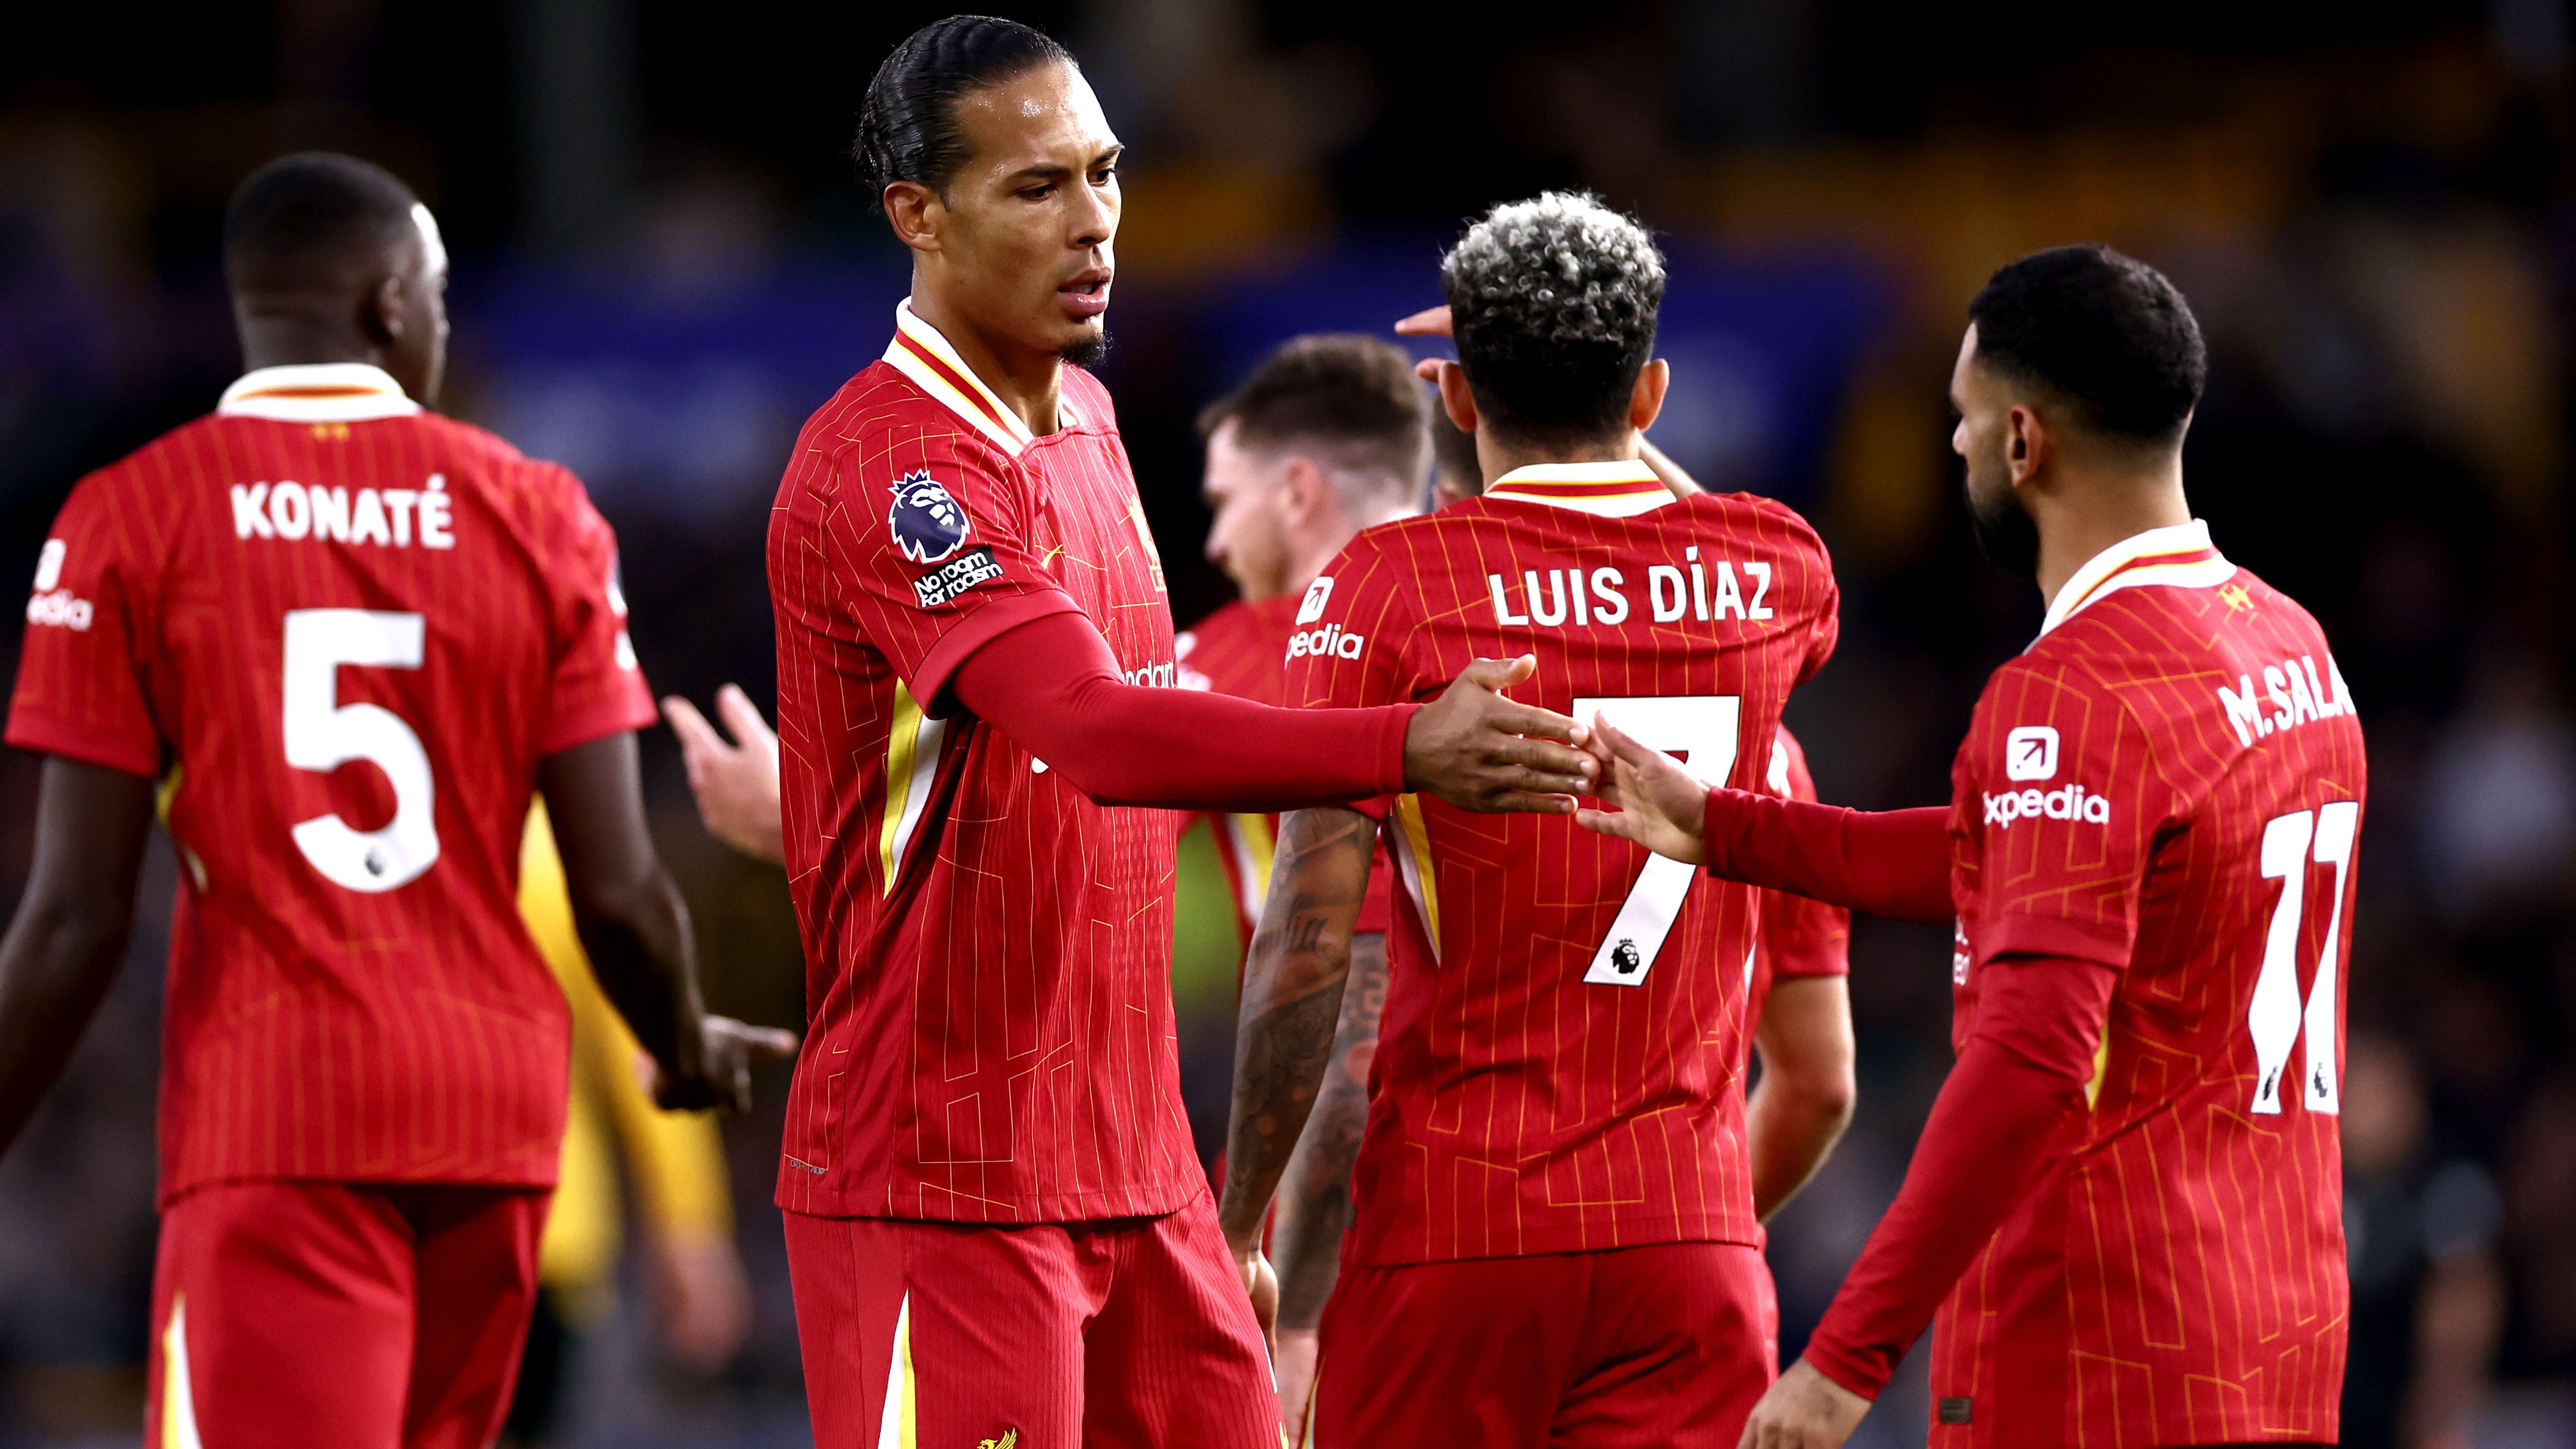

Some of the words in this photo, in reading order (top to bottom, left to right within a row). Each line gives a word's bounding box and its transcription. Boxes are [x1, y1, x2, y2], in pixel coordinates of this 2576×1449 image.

[231, 473, 456, 549] KONATÉ
[914, 575, 940, 598] No
[939, 552, 988, 583] room
[921, 588, 946, 608] for
[946, 563, 1004, 598] racism
[1488, 566, 1629, 627] LUIS
[1647, 545, 1774, 623] DÍAZ
[1284, 623, 1365, 670] pedia
[2217, 652, 2357, 747] M.SALA
[282, 608, 440, 893] 5
[1571, 695, 1741, 987] 7
[1982, 783, 2110, 829] xpedia
[2248, 801, 2359, 1115] 11
